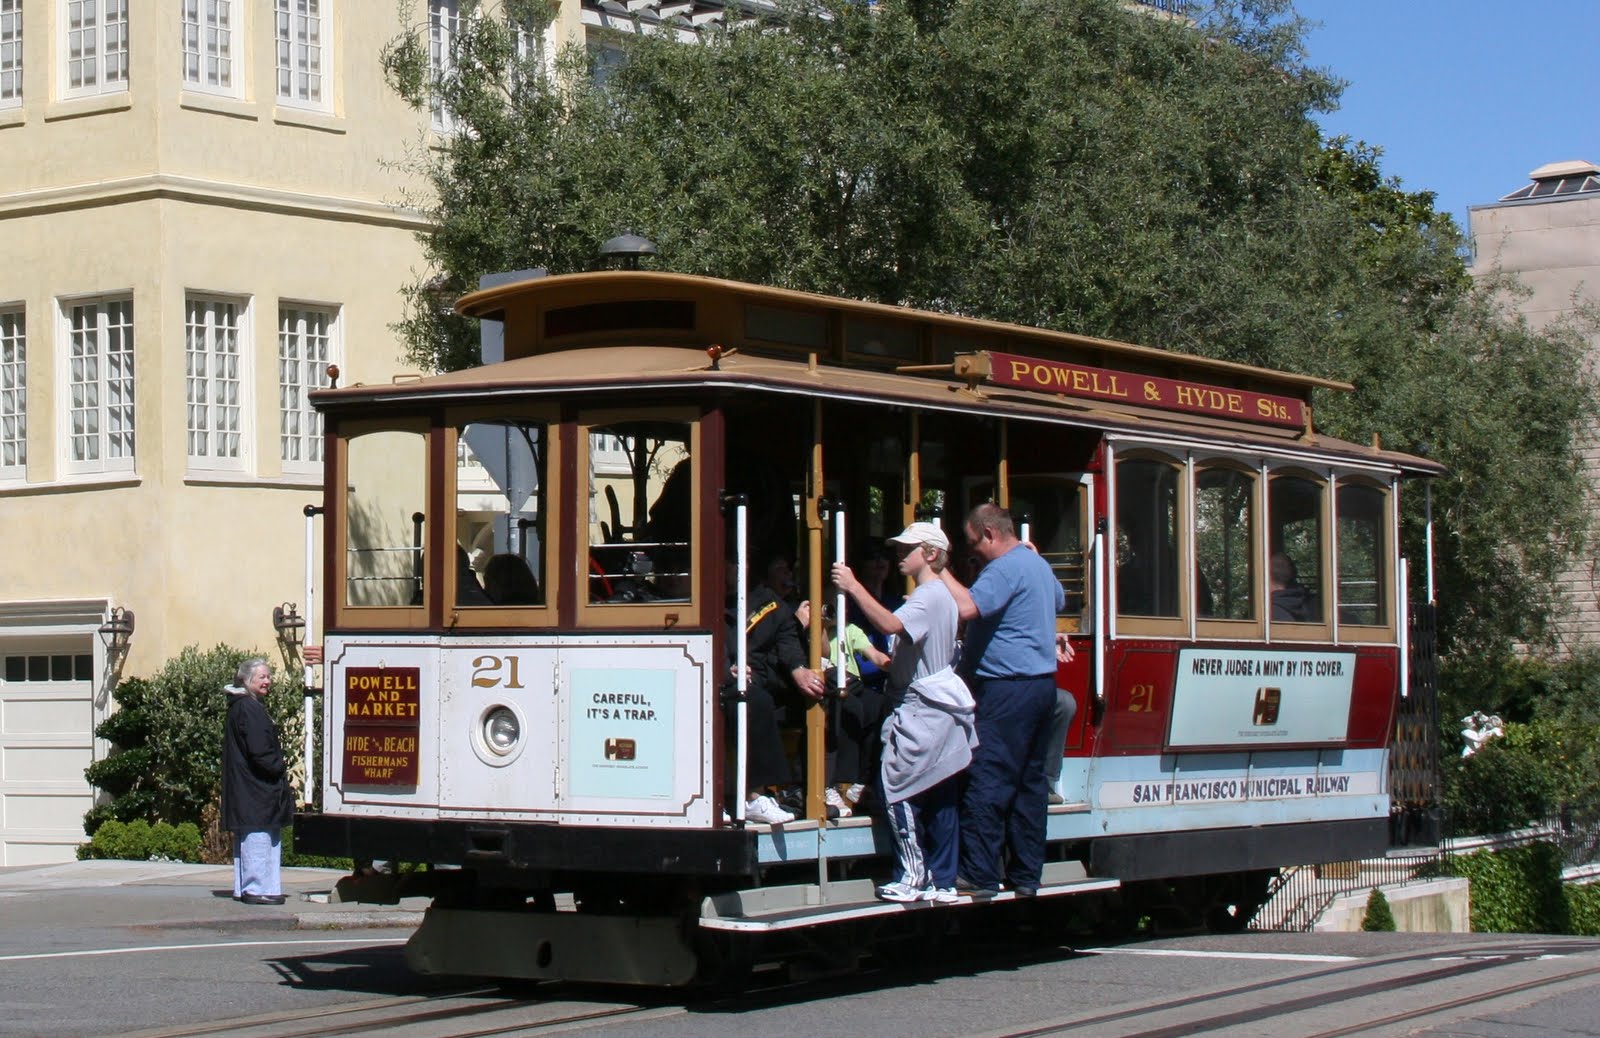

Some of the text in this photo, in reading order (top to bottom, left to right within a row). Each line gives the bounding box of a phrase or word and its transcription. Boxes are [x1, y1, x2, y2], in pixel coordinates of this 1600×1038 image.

[1009, 361, 1292, 420] POWELL & HYDE Sts.
[471, 655, 525, 689] 21
[1192, 658, 1344, 677] NEVER JUDGE A MINT BY ITS COVER.
[349, 676, 417, 690] POWELL
[366, 691, 401, 702] AND
[593, 693, 651, 707] CAREFUL,
[1127, 684, 1155, 713] 21
[347, 702, 418, 716] MARKET
[587, 708, 657, 721] IT'S A TRAP.
[346, 736, 370, 751] HYDE
[384, 736, 415, 753] BEACH
[351, 755, 409, 767] FISHERMANS
[364, 767, 394, 778] WHARF
[1133, 784, 1161, 803] SAN
[1165, 780, 1237, 801] FRANCISCO
[1305, 776, 1350, 795] RAILWAY
